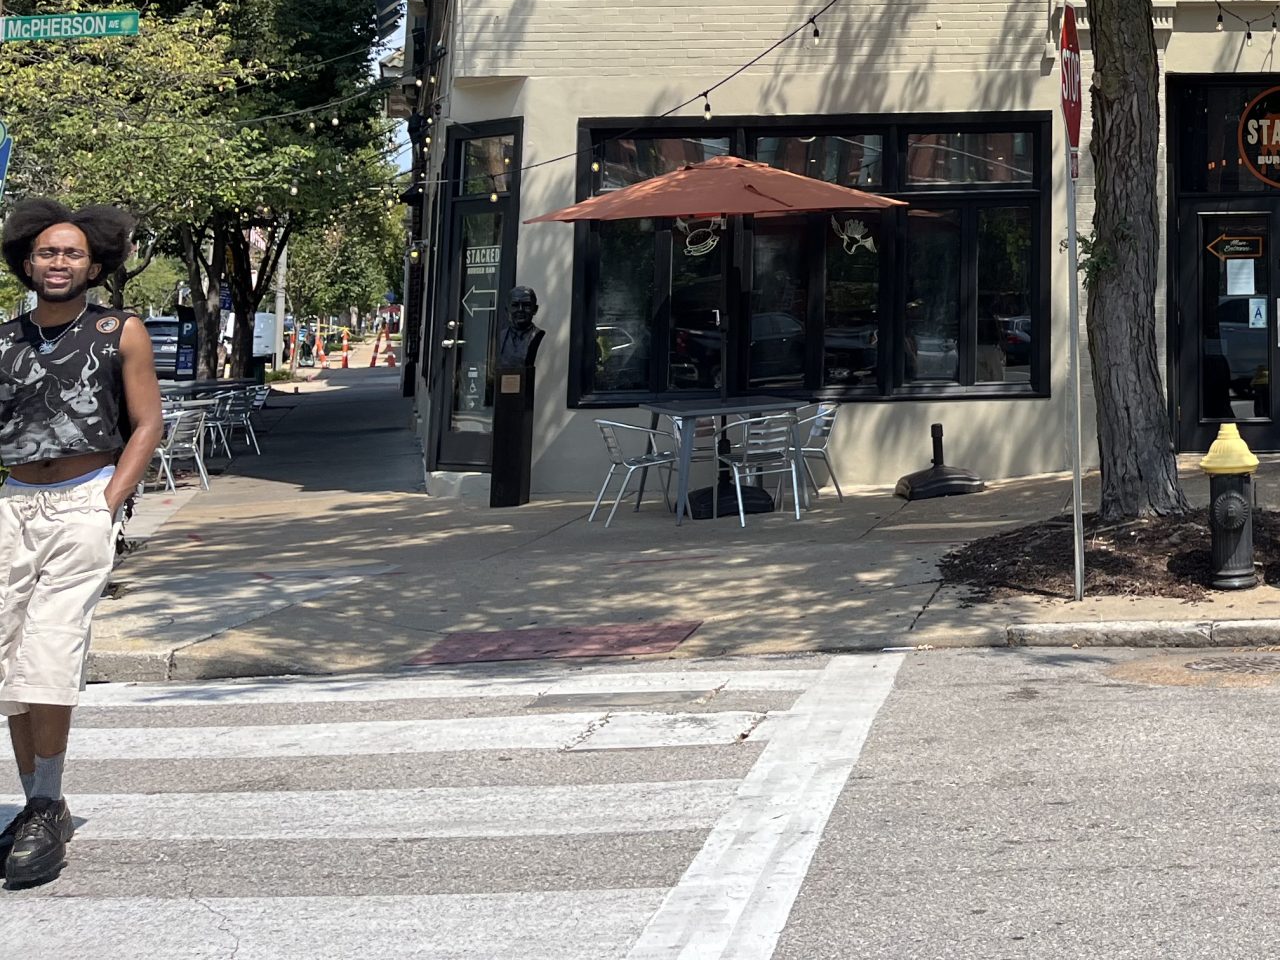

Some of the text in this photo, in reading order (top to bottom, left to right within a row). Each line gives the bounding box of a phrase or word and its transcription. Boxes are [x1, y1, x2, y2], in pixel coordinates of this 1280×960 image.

[7, 16, 119, 38] McPHERSON AVE
[1062, 48, 1080, 102] STOP
[466, 248, 500, 264] STACKED
[1254, 307, 1263, 319] A
[183, 323, 192, 335] P
